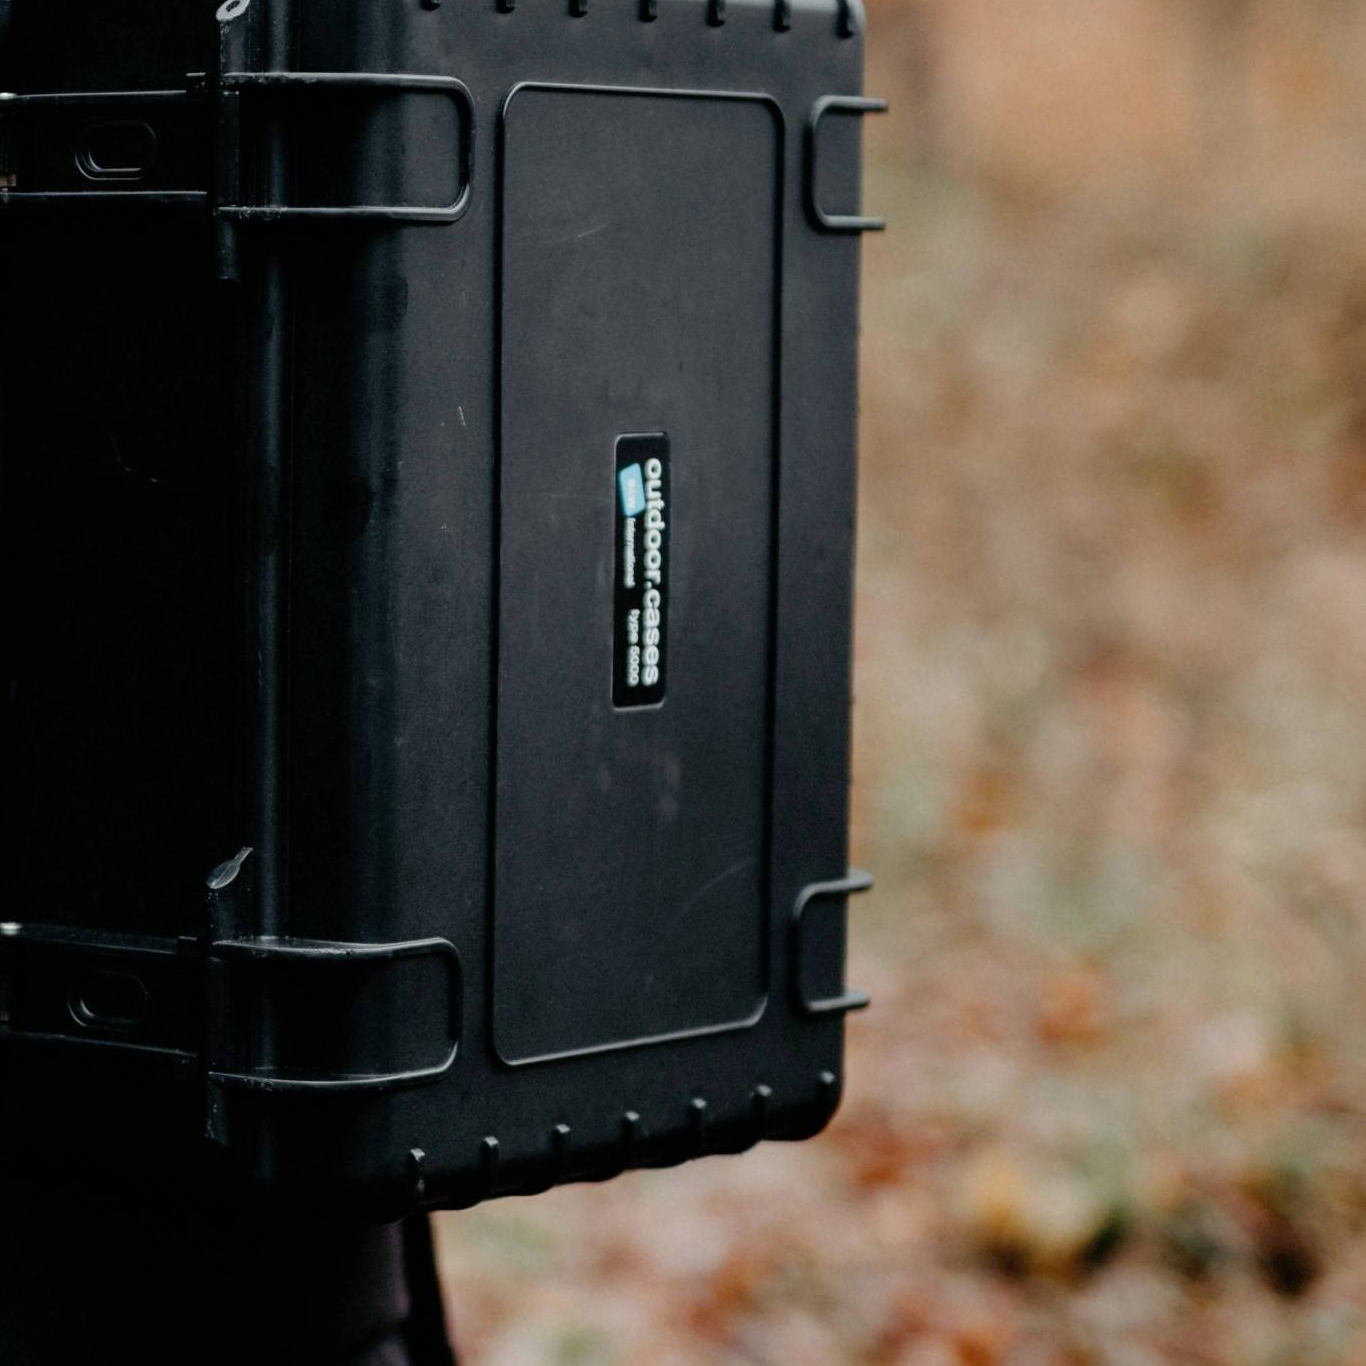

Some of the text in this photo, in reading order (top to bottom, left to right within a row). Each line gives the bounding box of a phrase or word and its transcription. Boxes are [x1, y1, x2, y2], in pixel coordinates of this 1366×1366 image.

[627, 609, 640, 686] type 5000
[642, 458, 665, 686] outdoor.cases
